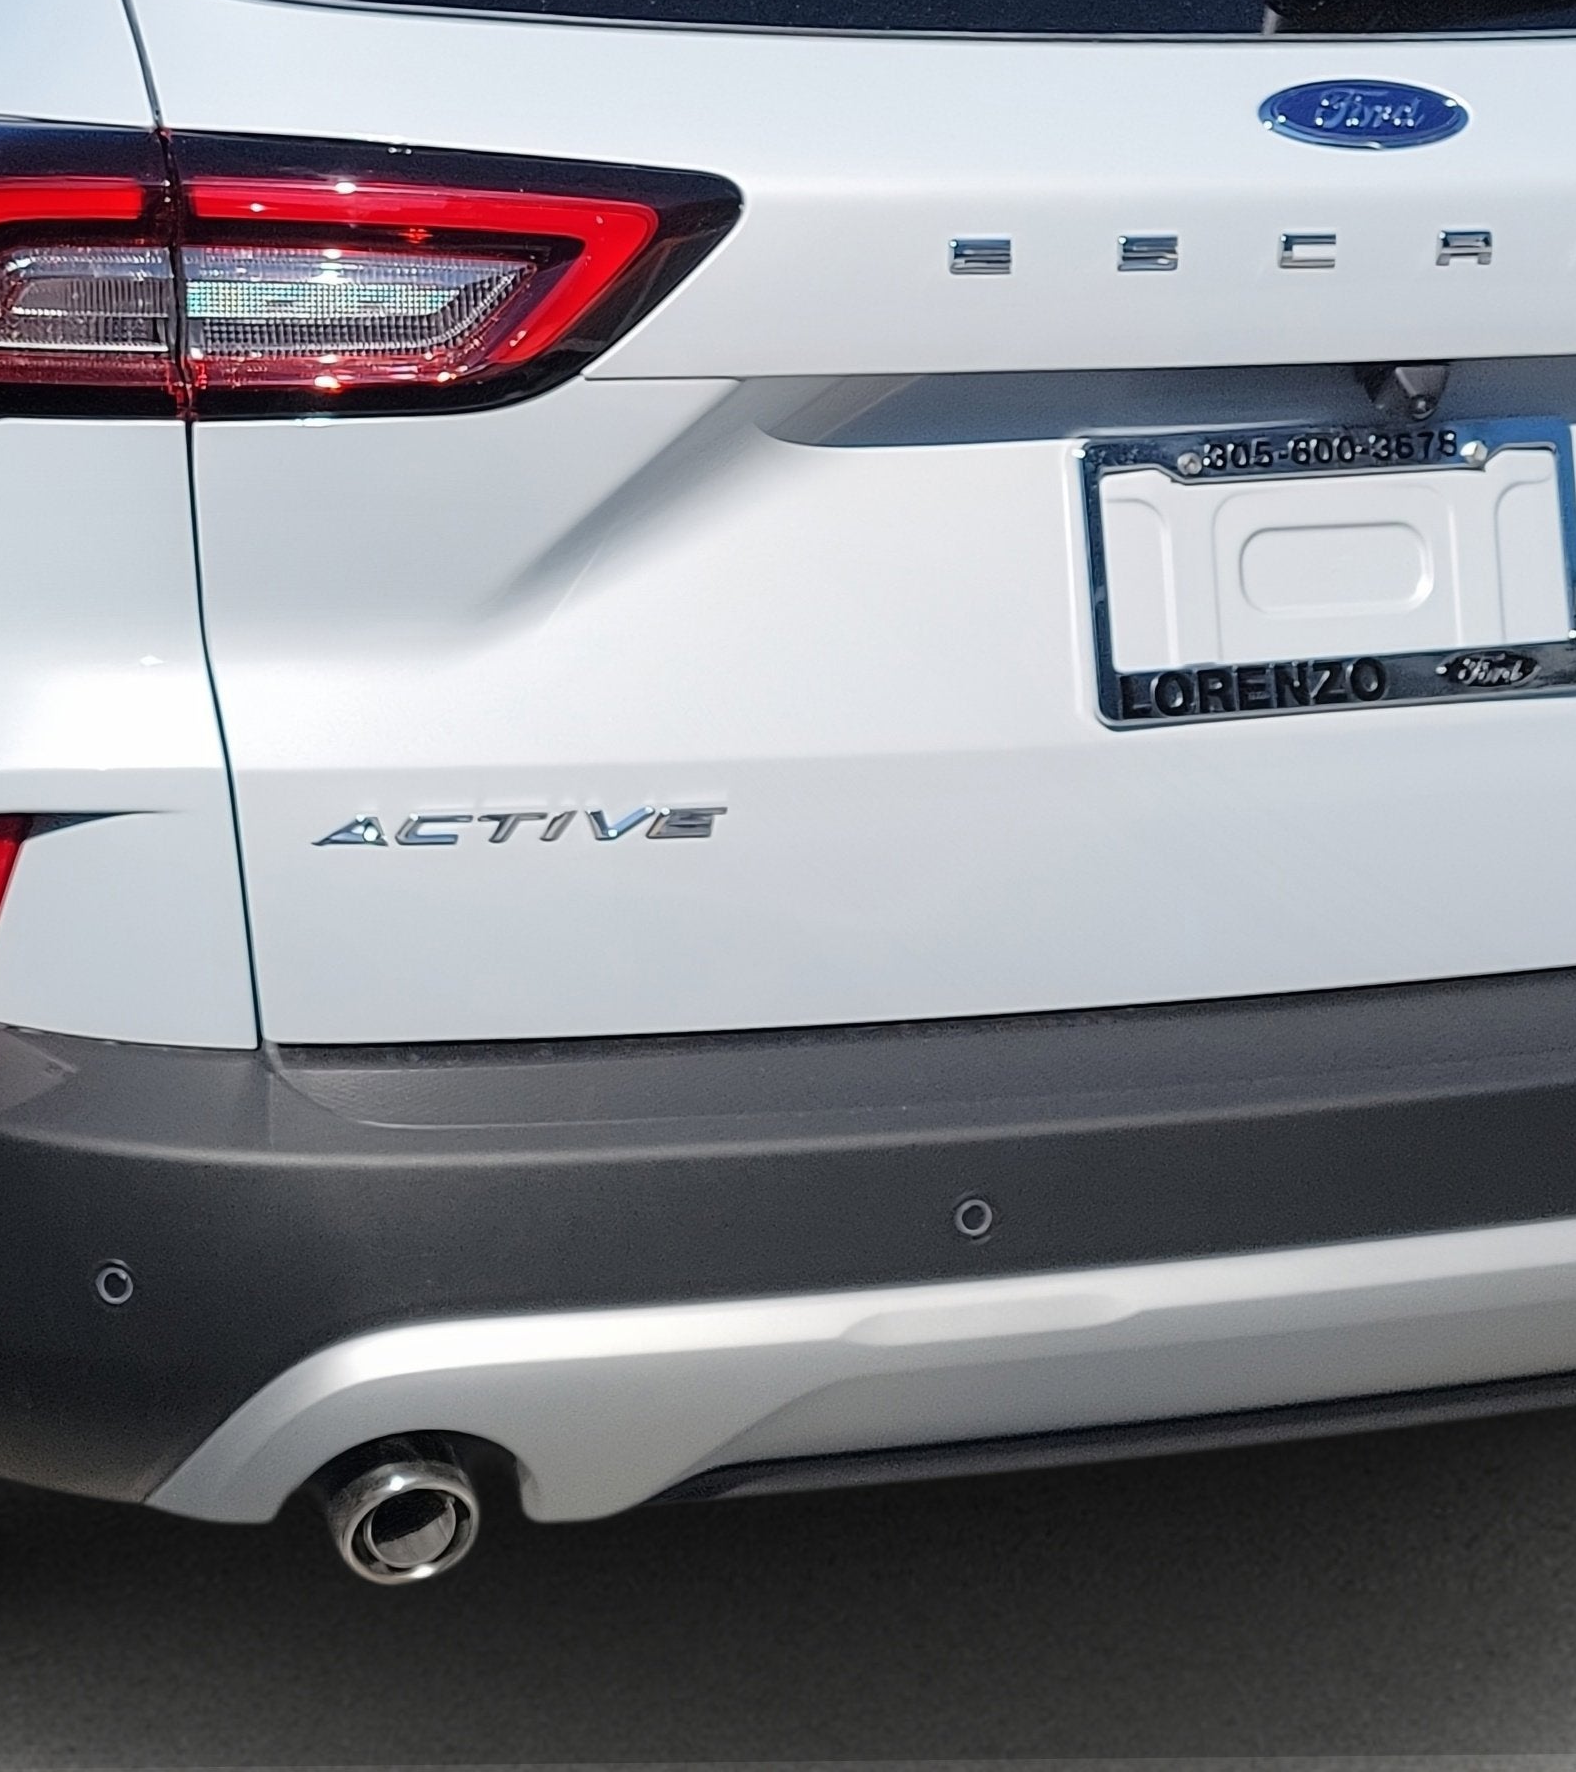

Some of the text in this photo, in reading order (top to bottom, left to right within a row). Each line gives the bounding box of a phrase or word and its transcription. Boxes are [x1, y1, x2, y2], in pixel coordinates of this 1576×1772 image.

[1315, 87, 1425, 129] Ford
[1119, 657, 1386, 719] LORENZO
[1457, 652, 1524, 685] Ford
[311, 805, 729, 847] ACTIVE
